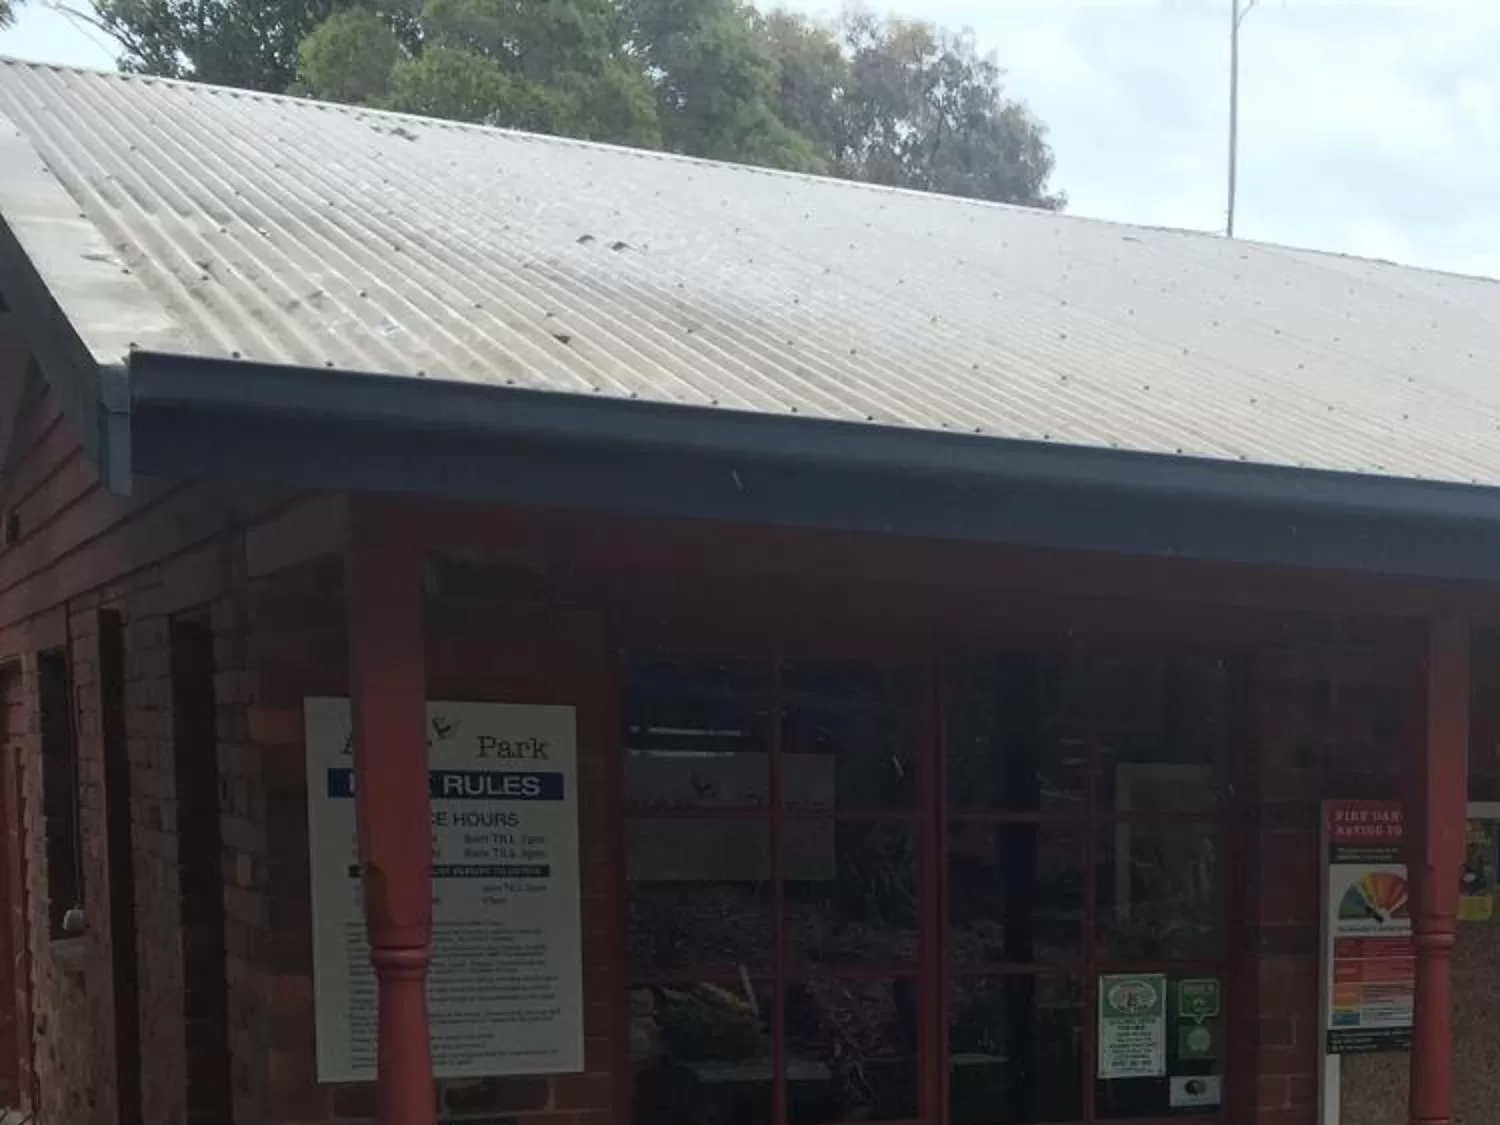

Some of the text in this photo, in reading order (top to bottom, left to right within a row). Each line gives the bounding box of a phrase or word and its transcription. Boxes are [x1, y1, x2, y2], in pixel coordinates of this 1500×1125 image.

[476, 735, 549, 760] Park
[443, 775, 541, 796] RULES
[453, 812, 520, 827] HOURS
